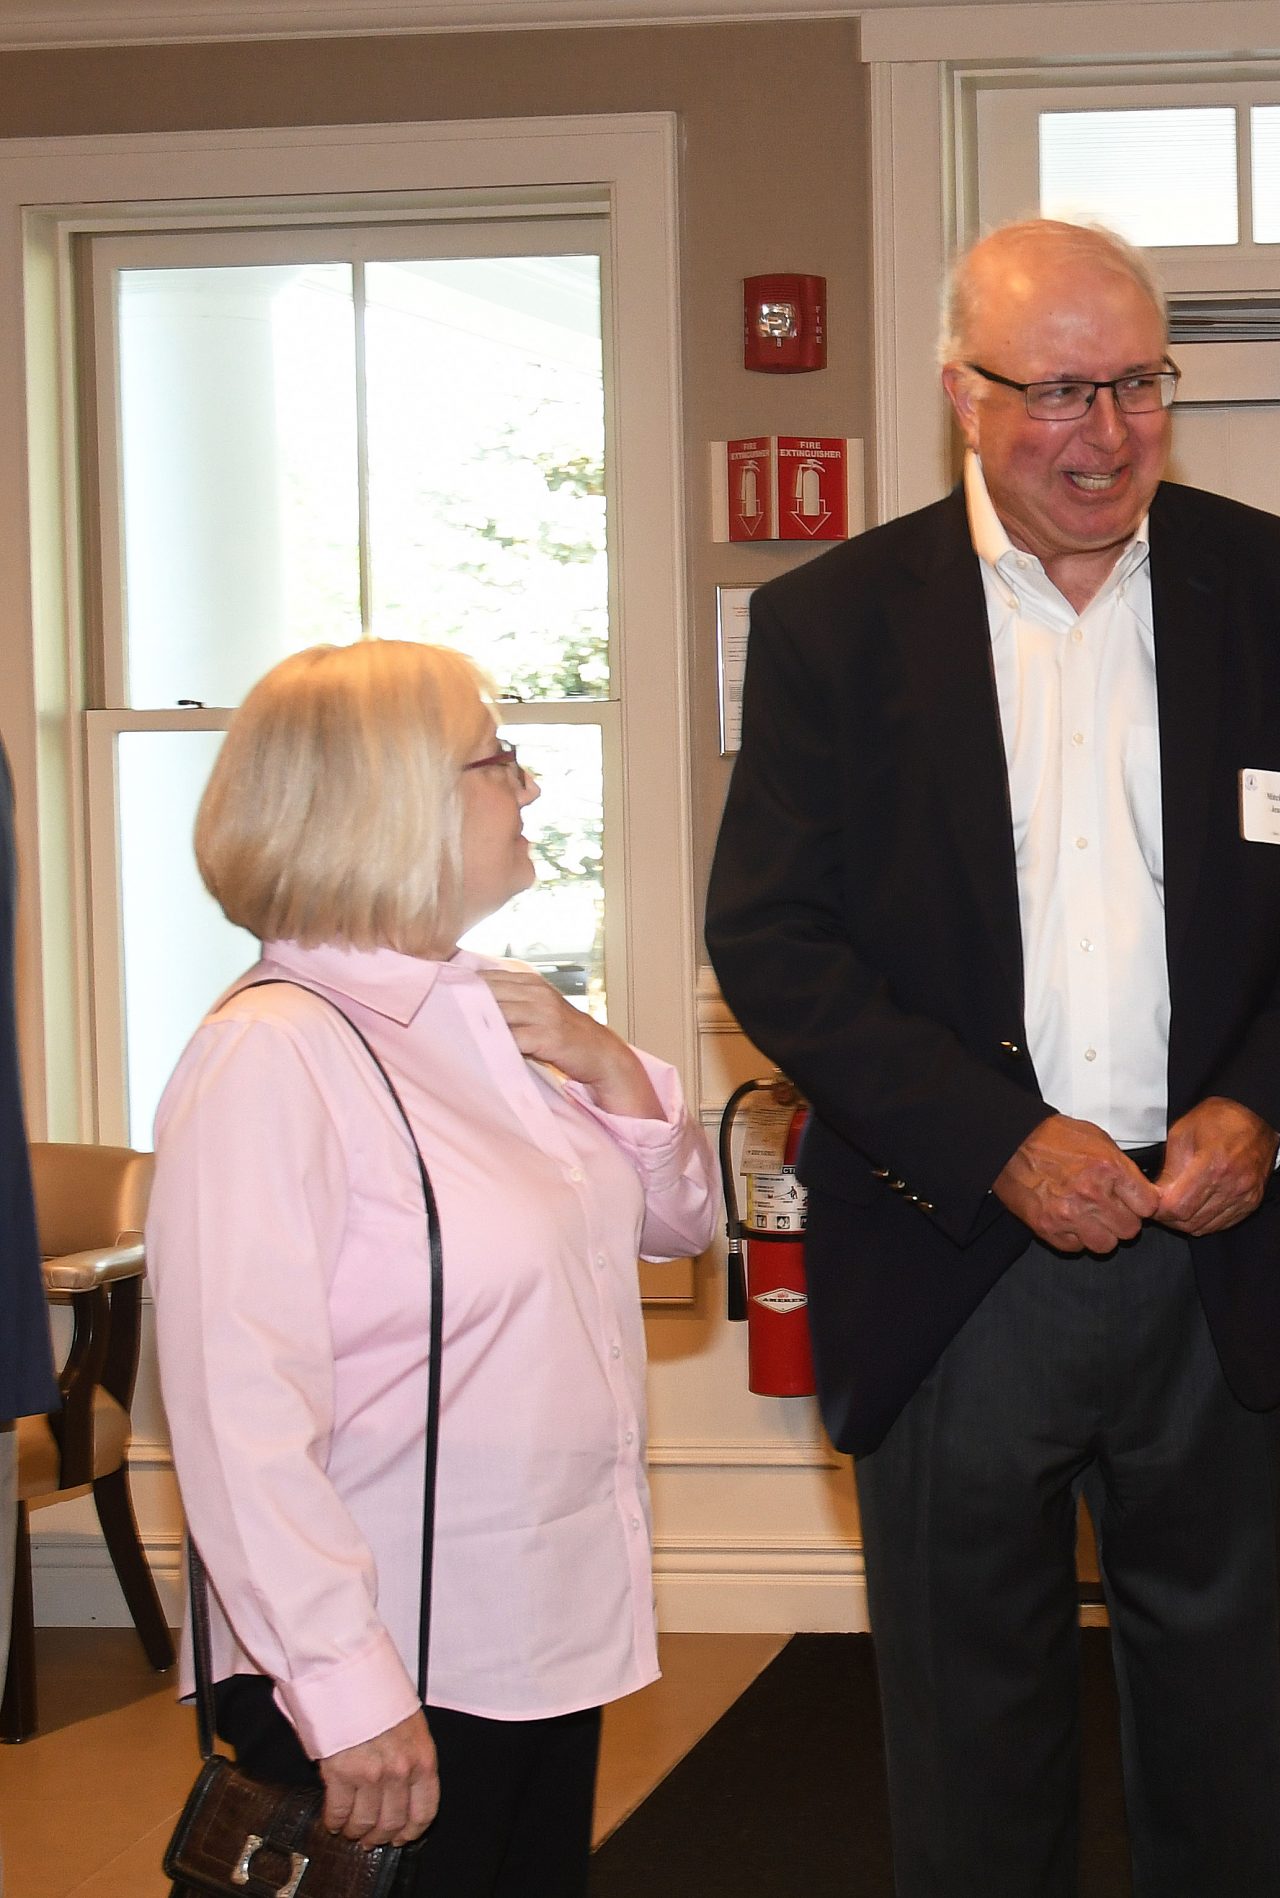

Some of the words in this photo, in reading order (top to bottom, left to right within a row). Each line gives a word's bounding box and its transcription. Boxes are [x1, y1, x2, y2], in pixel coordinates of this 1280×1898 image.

[743, 442, 757, 451] FIRE
[800, 441, 821, 450] FIRE
[731, 449, 770, 460] EXTINGUISHER
[780, 449, 841, 459] EXTINGUISHER
